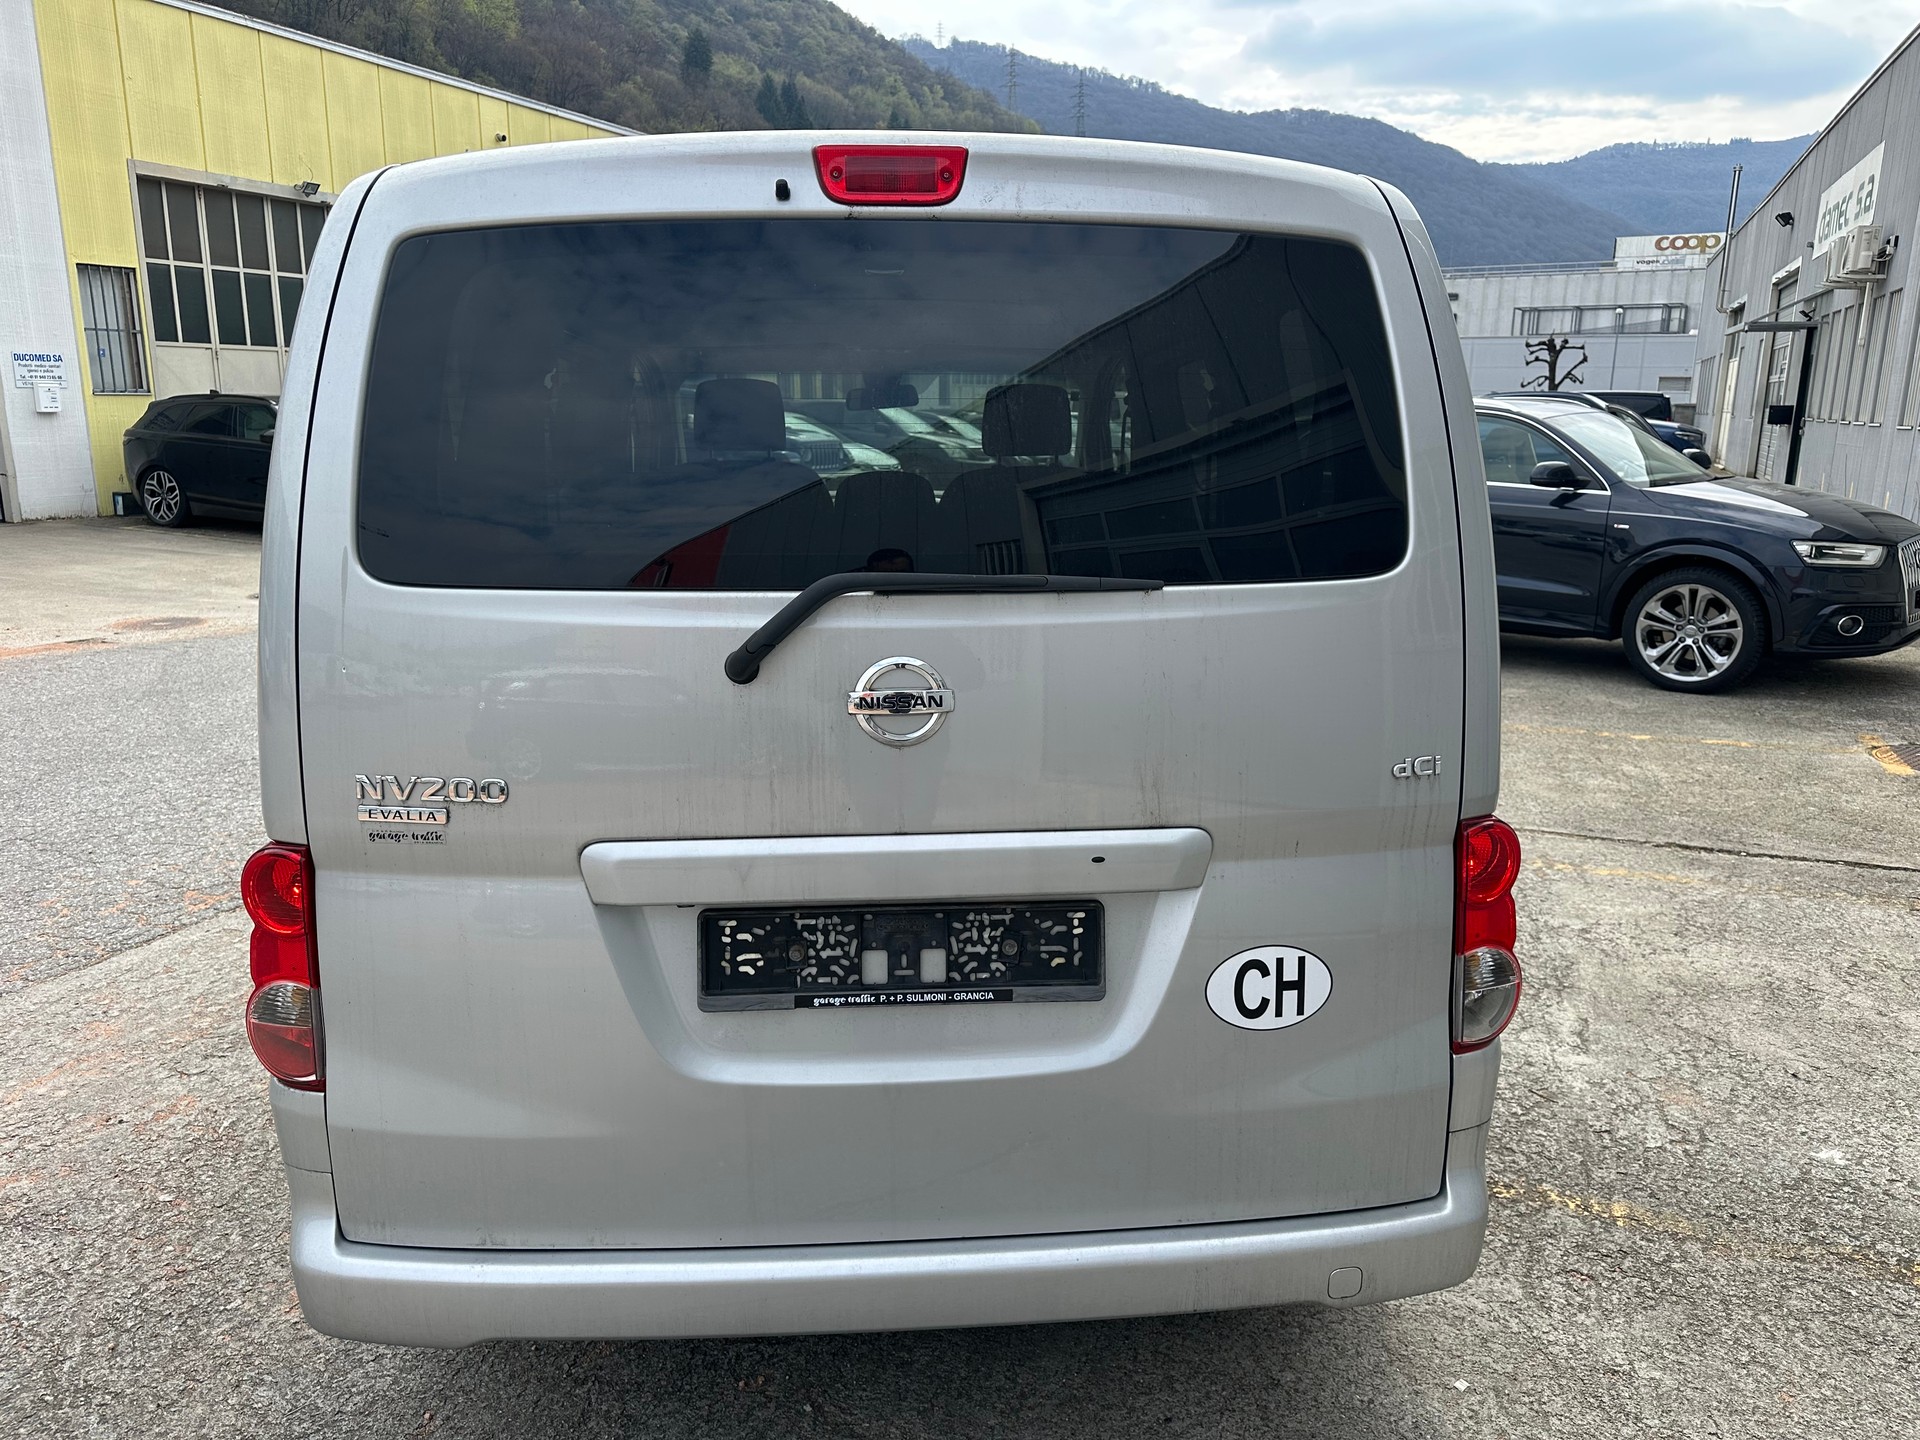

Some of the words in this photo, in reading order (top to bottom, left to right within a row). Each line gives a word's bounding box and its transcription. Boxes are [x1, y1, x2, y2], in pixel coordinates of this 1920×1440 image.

[1655, 235, 1721, 253] coop
[13, 353, 51, 362] DUCOMED
[52, 354, 63, 362] SA
[860, 694, 943, 709] NISSAN
[1392, 755, 1442, 778] dCi
[355, 774, 509, 803] NV200
[368, 809, 438, 822] EVALIA
[368, 832, 409, 843] garage
[411, 831, 444, 841] traffic
[1234, 956, 1306, 1020] CH
[813, 997, 846, 1007] garage
[848, 994, 876, 1003] traffic
[880, 994, 888, 1003] P.
[897, 994, 905, 1002] P.
[906, 993, 947, 1002] SULMONI
[953, 991, 994, 1001] GRANCIA
